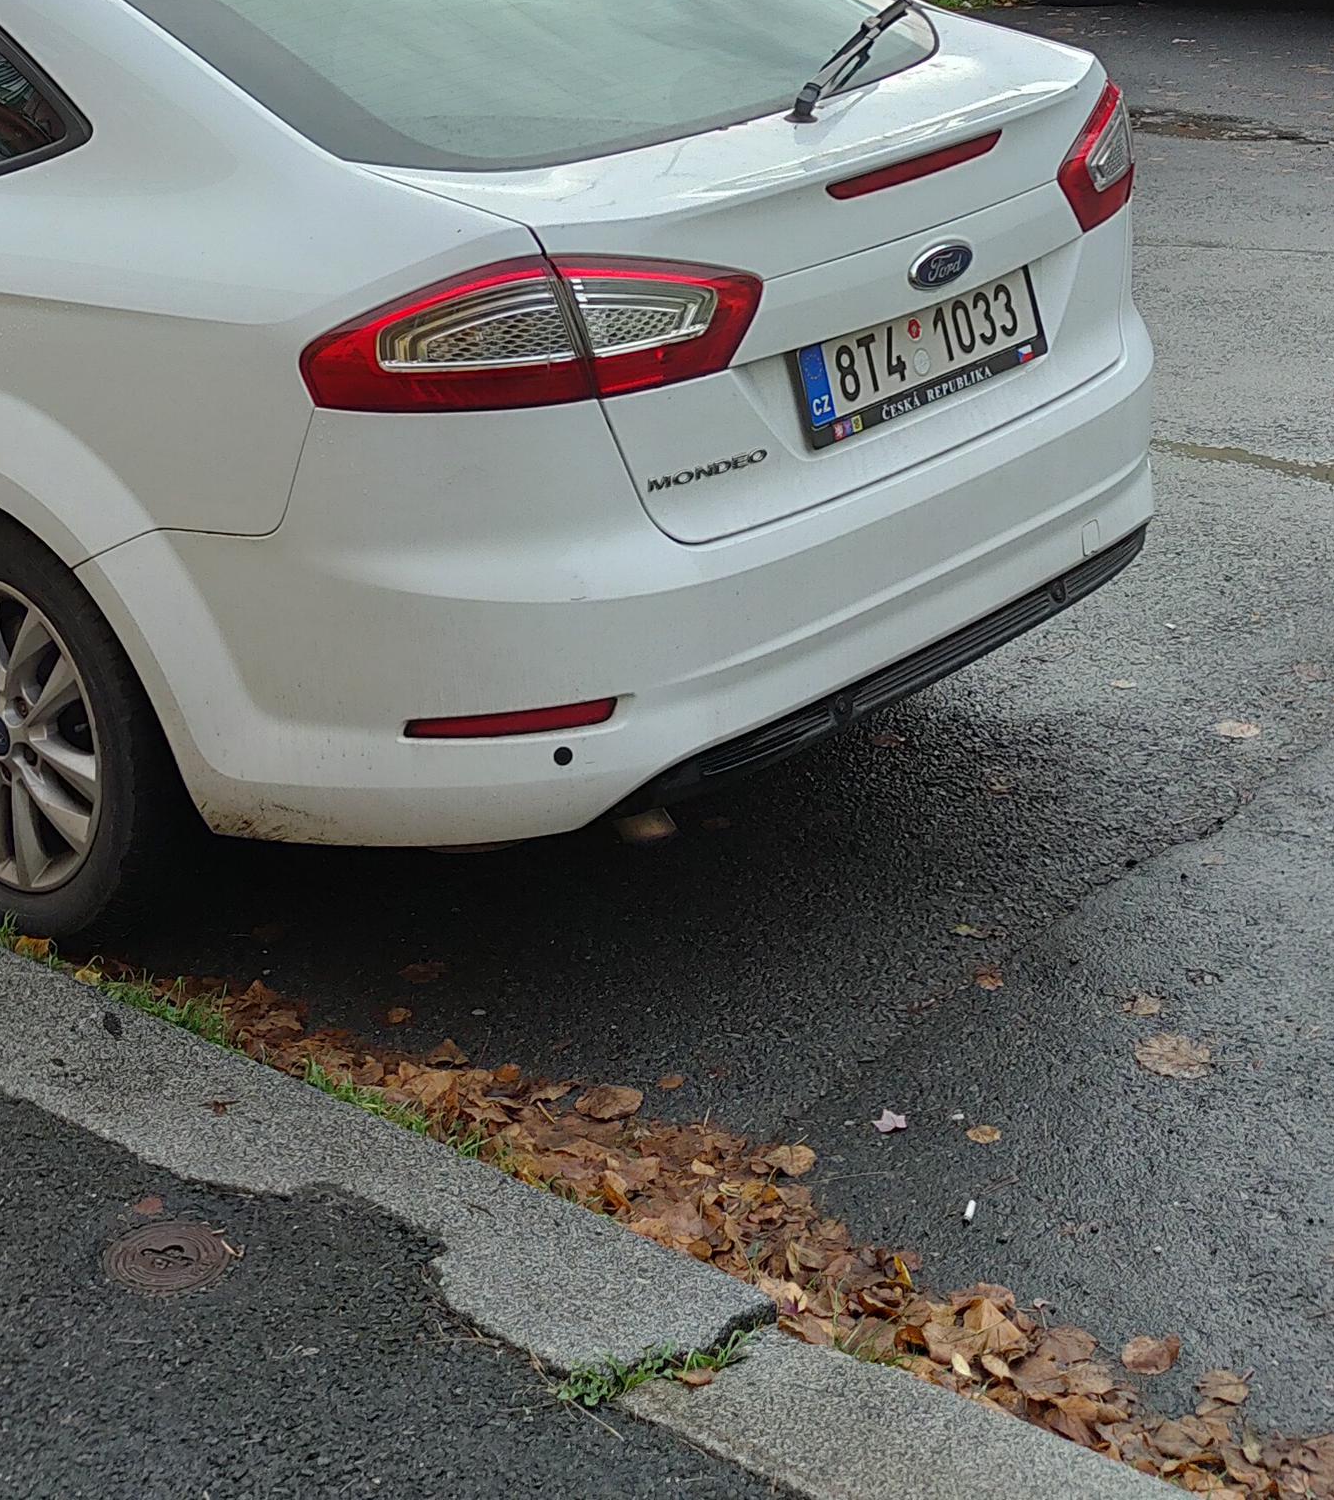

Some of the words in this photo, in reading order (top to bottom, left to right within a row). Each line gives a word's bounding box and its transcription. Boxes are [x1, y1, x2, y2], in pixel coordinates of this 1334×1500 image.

[927, 252, 963, 283] Ford
[812, 394, 832, 417] CZ
[835, 326, 907, 402] 8T4
[932, 283, 1019, 362] 1033
[881, 393, 921, 421] ČESKÁ
[926, 365, 993, 403] REPUBLIKA
[647, 448, 768, 493] MONDEO
